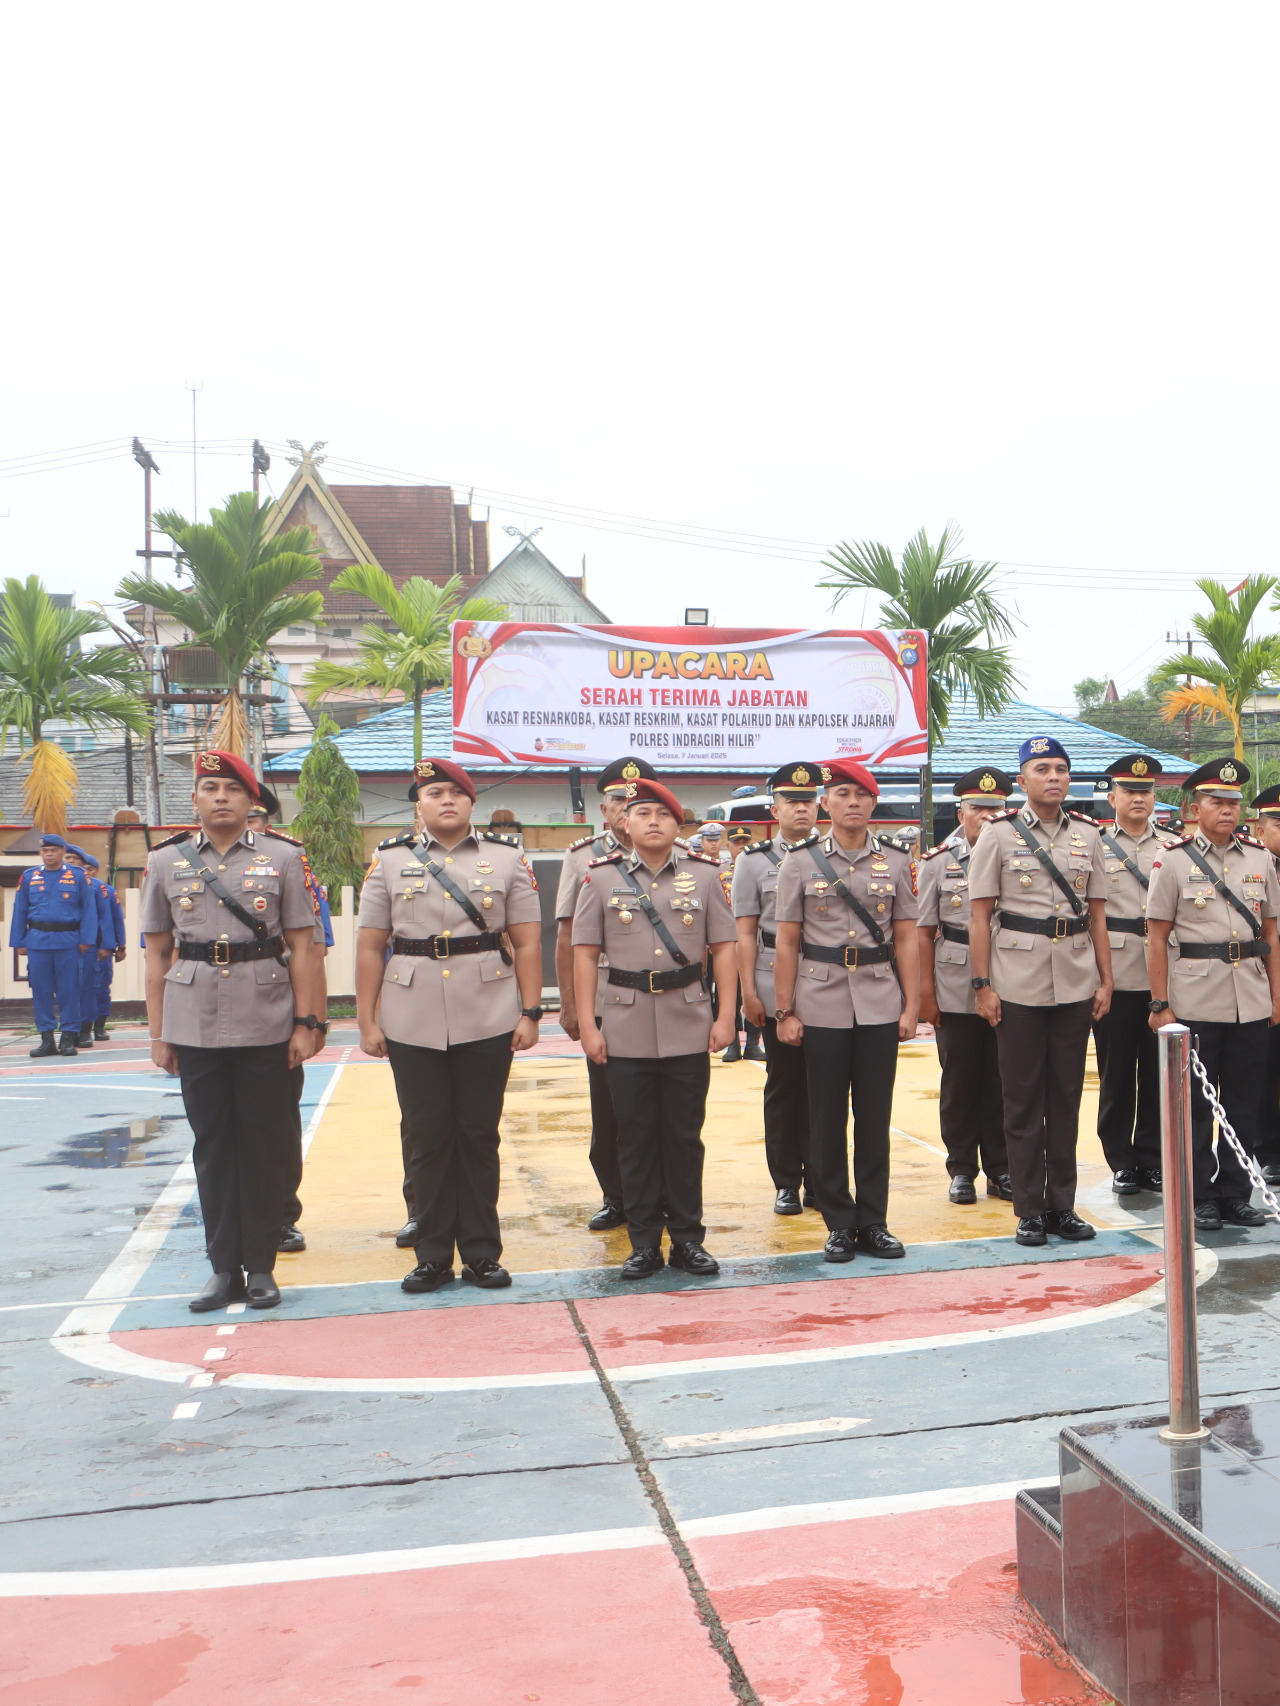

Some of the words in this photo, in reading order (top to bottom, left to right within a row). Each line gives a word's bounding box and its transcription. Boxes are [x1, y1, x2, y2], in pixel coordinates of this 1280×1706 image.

[608, 650, 774, 680] UPACARA
[580, 687, 642, 706] SERAH
[649, 688, 721, 707] TERIMA
[727, 689, 809, 708] JABATAN
[486, 711, 518, 726] KASAT
[523, 711, 595, 728] RESNARKOBA,
[599, 712, 630, 727] KASAT
[634, 712, 684, 729] RESKRIM,
[687, 713, 718, 727] KASAT
[722, 713, 772, 727] POLAIRUD
[775, 713, 795, 728] DAN
[799, 713, 849, 728] KAPOLSEK
[852, 713, 895, 729] JAJARAN
[630, 733, 669, 747] POLRES
[672, 733, 725, 747] INDRAGIRI
